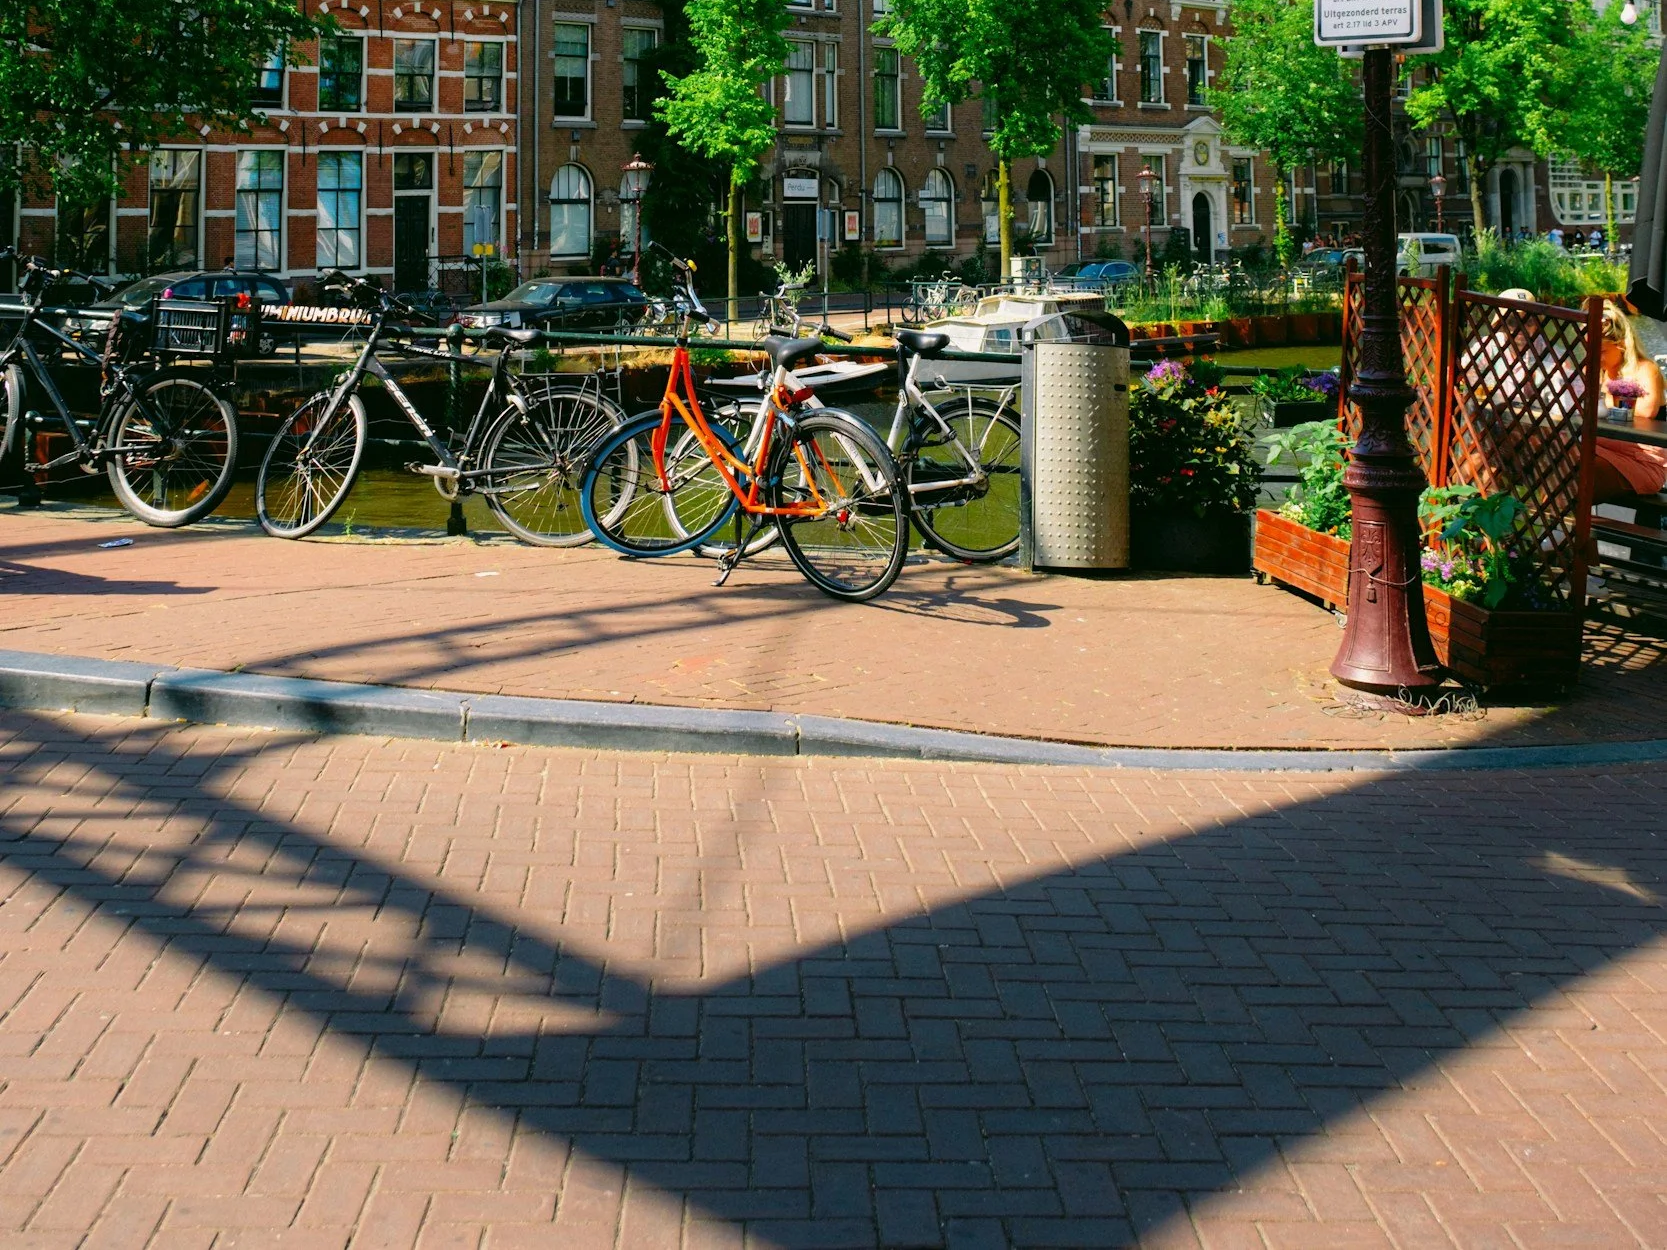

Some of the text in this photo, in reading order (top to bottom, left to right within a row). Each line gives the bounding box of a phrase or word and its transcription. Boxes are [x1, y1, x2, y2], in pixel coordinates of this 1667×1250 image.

[1323, 7, 1407, 19] Uitgezonderd terras
[1362, 20, 1372, 28] lid
[1374, 19, 1380, 27] 3
